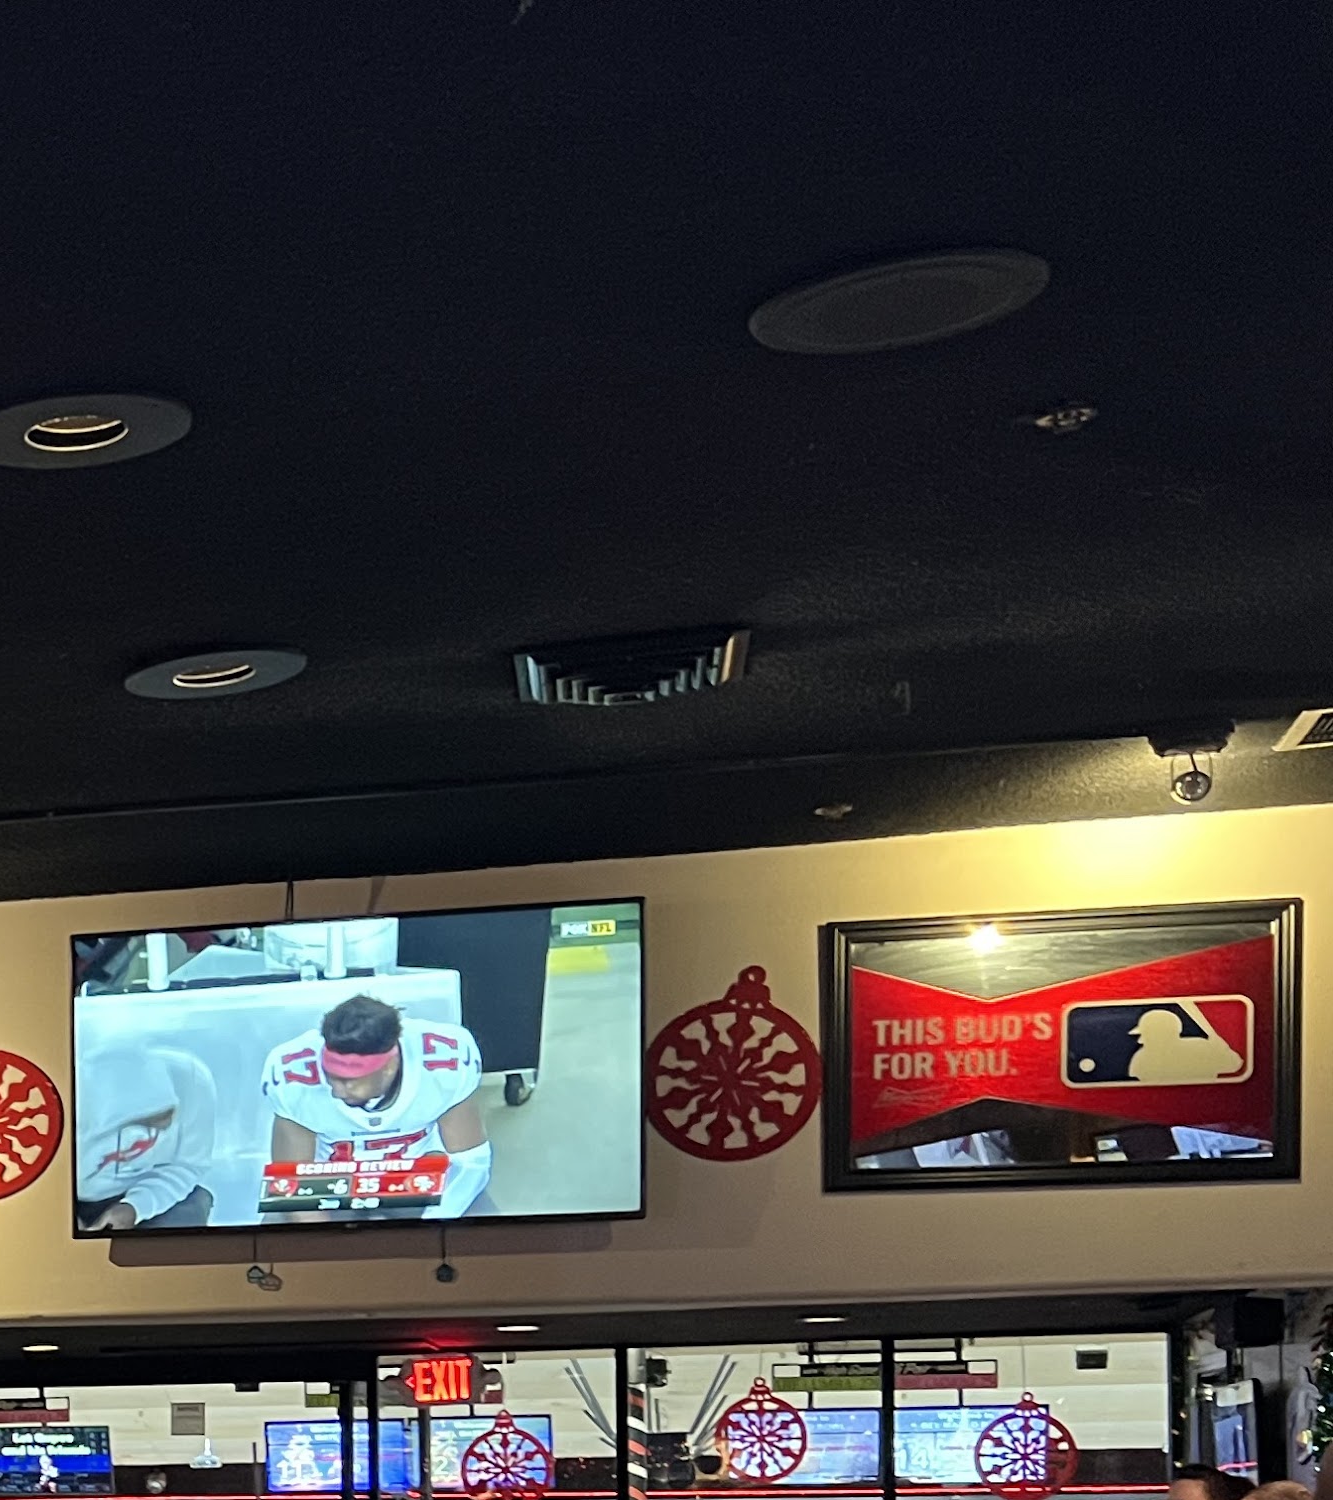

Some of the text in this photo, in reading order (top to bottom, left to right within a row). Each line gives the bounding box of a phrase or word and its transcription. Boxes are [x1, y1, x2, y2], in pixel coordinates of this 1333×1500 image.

[590, 921, 613, 934] NFL
[871, 1012, 1054, 1047] THIS BUD'S
[421, 1032, 459, 1072] 17
[871, 1048, 1019, 1081] FOR YOU.
[359, 1159, 415, 1173] REVIEW
[355, 1177, 381, 1194] 35
[413, 1358, 473, 1403] EXIT
